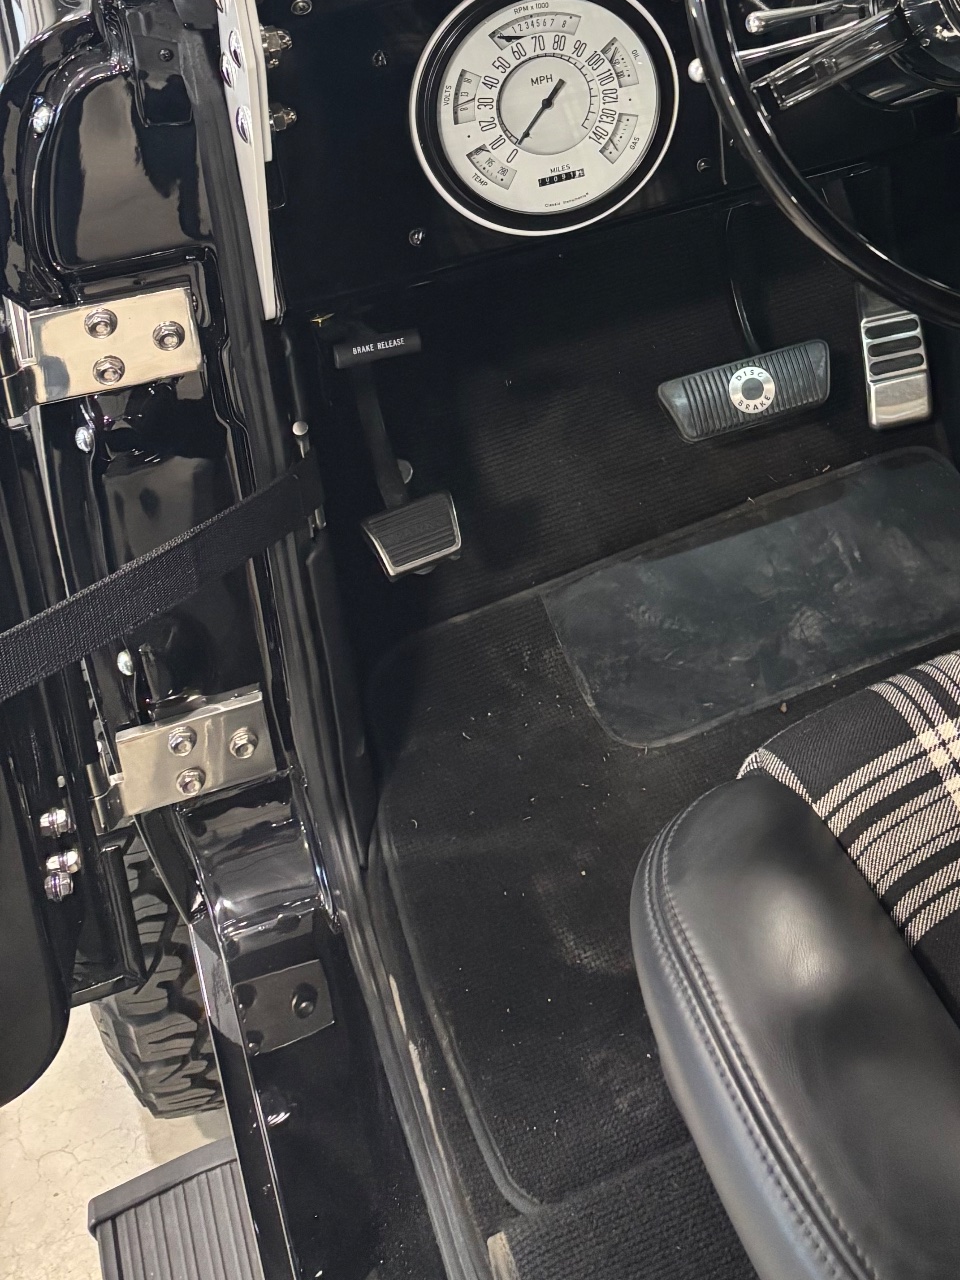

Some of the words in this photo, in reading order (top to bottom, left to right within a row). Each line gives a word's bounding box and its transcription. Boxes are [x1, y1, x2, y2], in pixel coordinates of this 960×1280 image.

[513, 5, 529, 15] RPM
[531, 34, 545, 53] 70
[552, 34, 566, 51] 80
[572, 40, 587, 57] 90
[511, 42, 527, 60] 60
[631, 49, 639, 60] OIL
[492, 56, 510, 73] 50
[585, 50, 605, 70] 100
[482, 75, 499, 90] 40
[530, 74, 553, 86] MPH
[596, 69, 614, 86] 110
[443, 85, 452, 107] VOLTS
[477, 97, 494, 110] 30
[602, 88, 618, 105] 120
[478, 116, 497, 132] 20
[598, 108, 616, 124] 130
[489, 134, 506, 150] 10
[589, 125, 608, 145] 140
[629, 137, 640, 150] GAS
[506, 148, 518, 163] 0
[550, 164, 571, 174] MILES
[472, 172, 488, 186] TEMP
[352, 343, 375, 355] BRAKE
[377, 337, 405, 350] RELEASE
[735, 369, 764, 382] DISC
[737, 394, 771, 411] BRAKE
